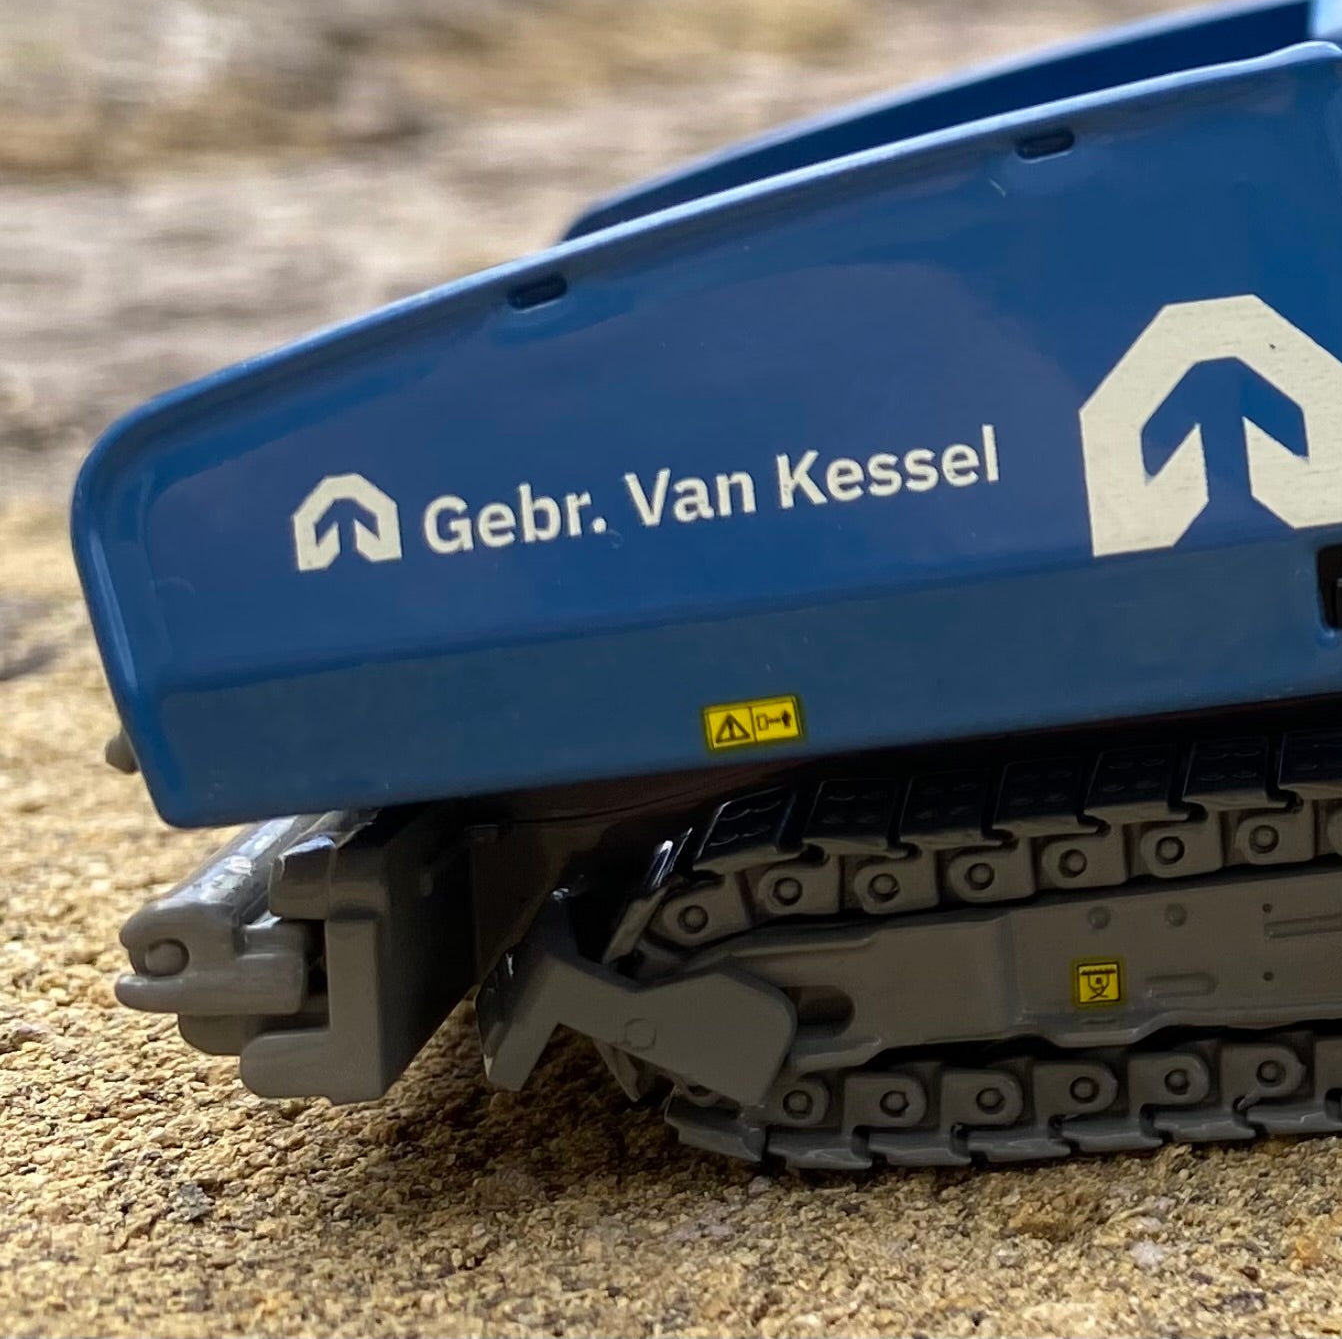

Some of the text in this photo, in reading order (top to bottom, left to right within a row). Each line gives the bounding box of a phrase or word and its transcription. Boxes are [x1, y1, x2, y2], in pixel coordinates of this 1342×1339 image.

[422, 424, 1000, 554] Gebr. Van Kessel
